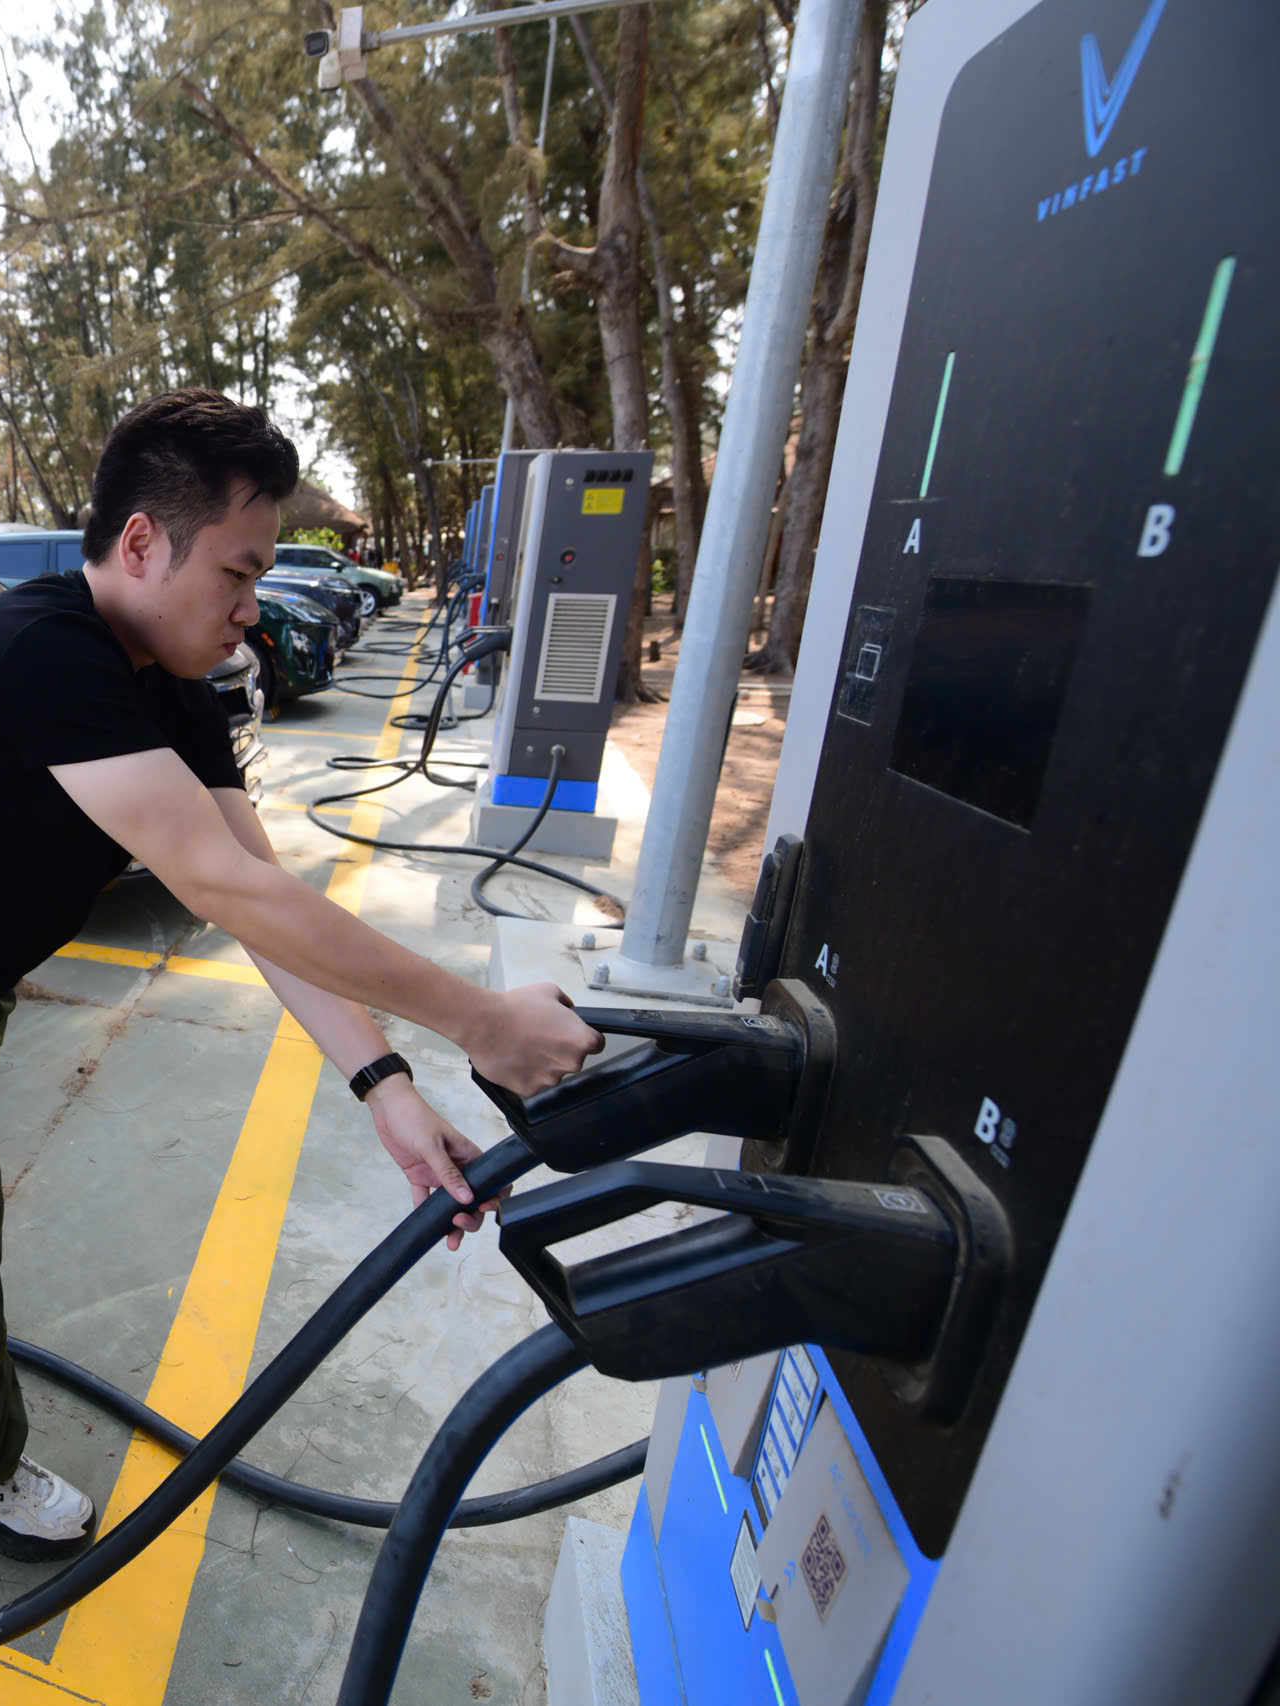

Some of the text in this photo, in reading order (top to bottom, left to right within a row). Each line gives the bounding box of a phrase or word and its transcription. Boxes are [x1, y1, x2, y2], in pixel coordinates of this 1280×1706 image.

[1036, 145, 1148, 222] VINFAST
[903, 518, 921, 554] A
[1137, 504, 1176, 558] B
[815, 943, 829, 977] A
[974, 1096, 1001, 1144] B
